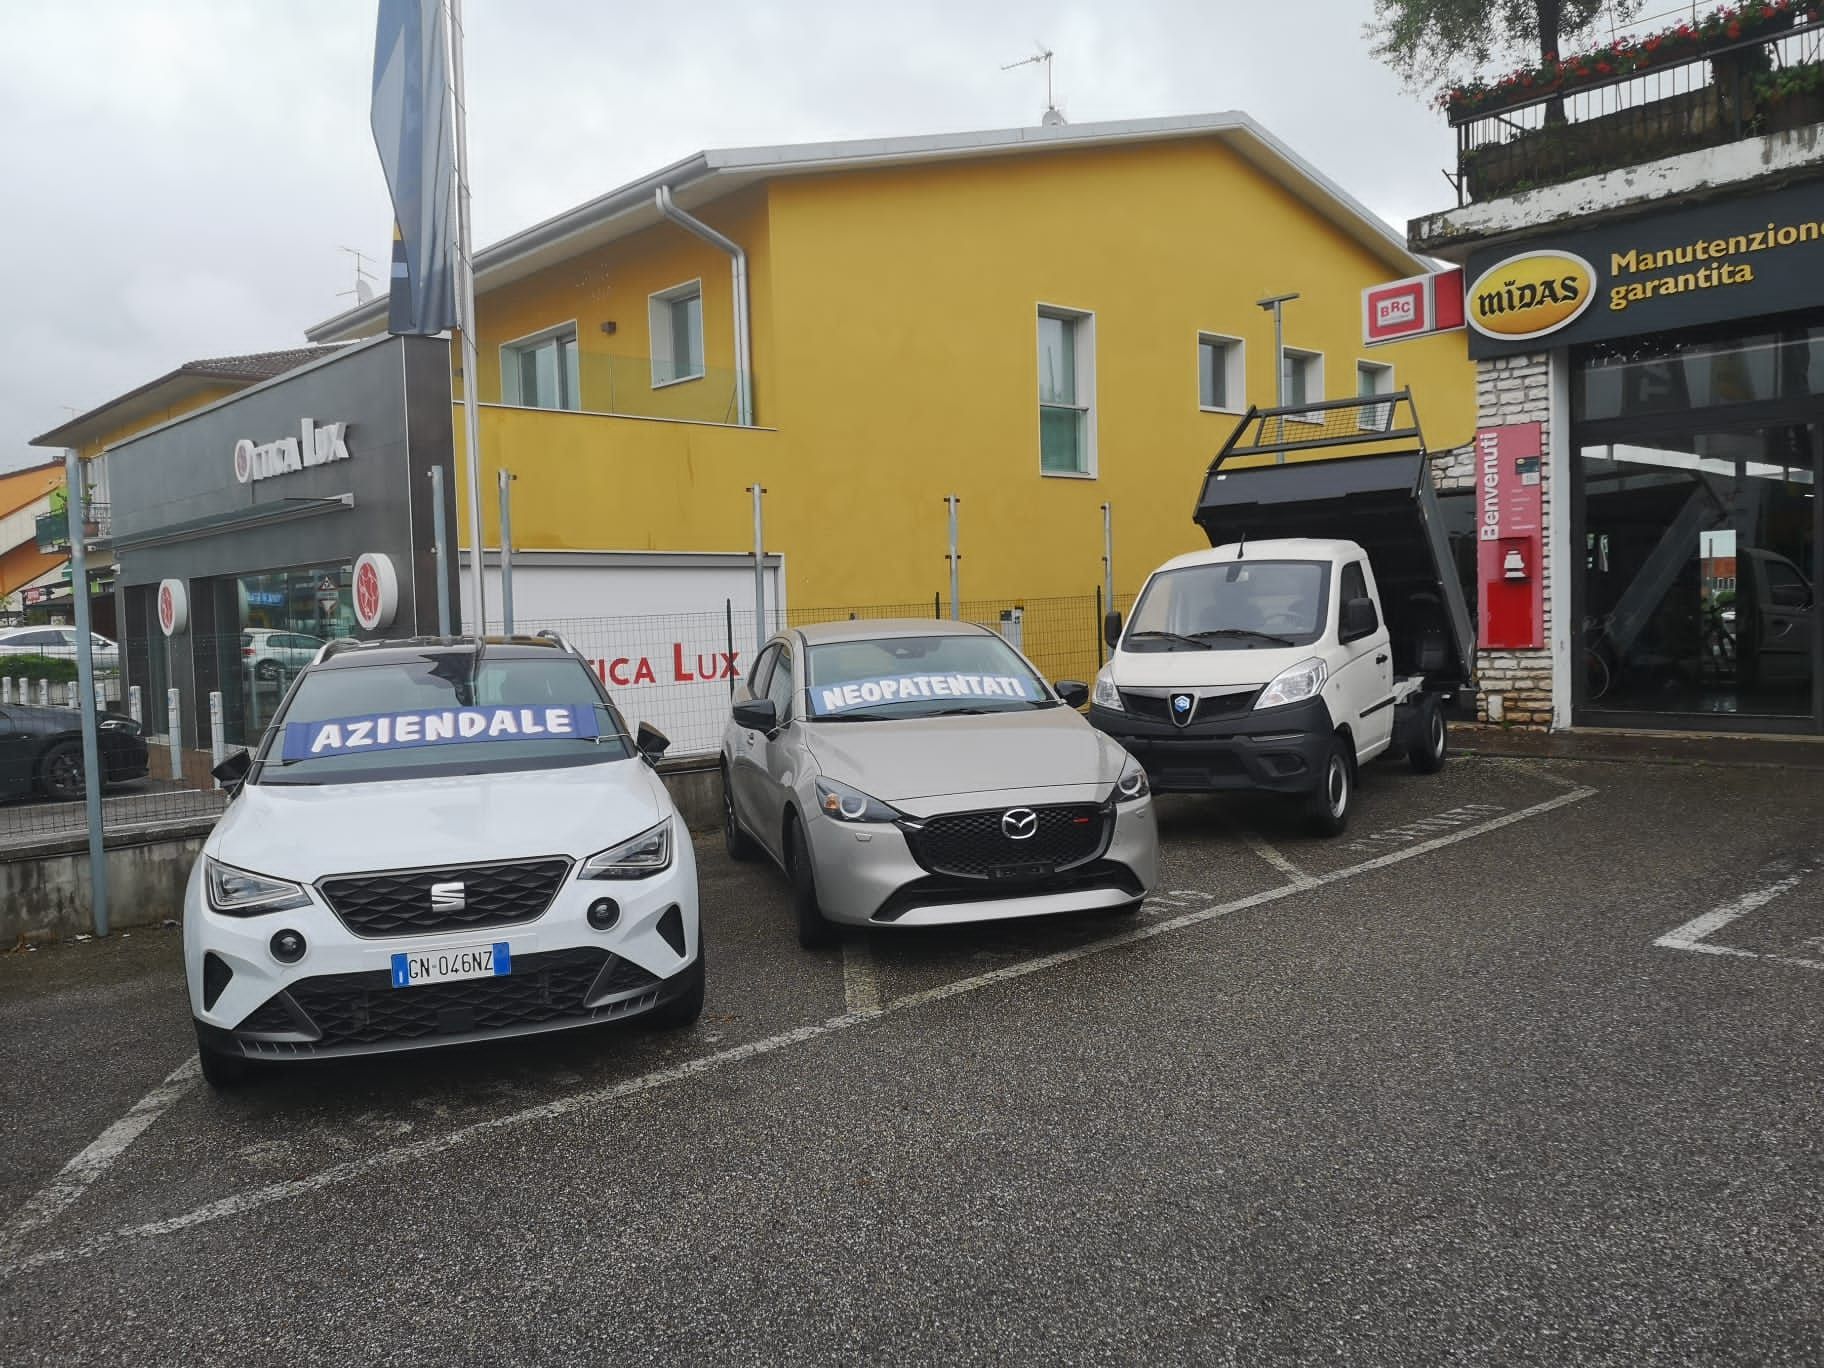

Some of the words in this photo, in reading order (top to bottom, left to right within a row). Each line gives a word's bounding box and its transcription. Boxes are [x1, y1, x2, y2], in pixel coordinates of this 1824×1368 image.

[1610, 222, 1824, 276] Manutenzion
[1609, 262, 1754, 310] garantita
[1380, 301, 1411, 318] BRC
[1480, 433, 1499, 540] Benvenuti
[586, 656, 656, 687] ICA
[823, 675, 1027, 711] NEOPATENTATI
[311, 708, 573, 752] AZIENDALE
